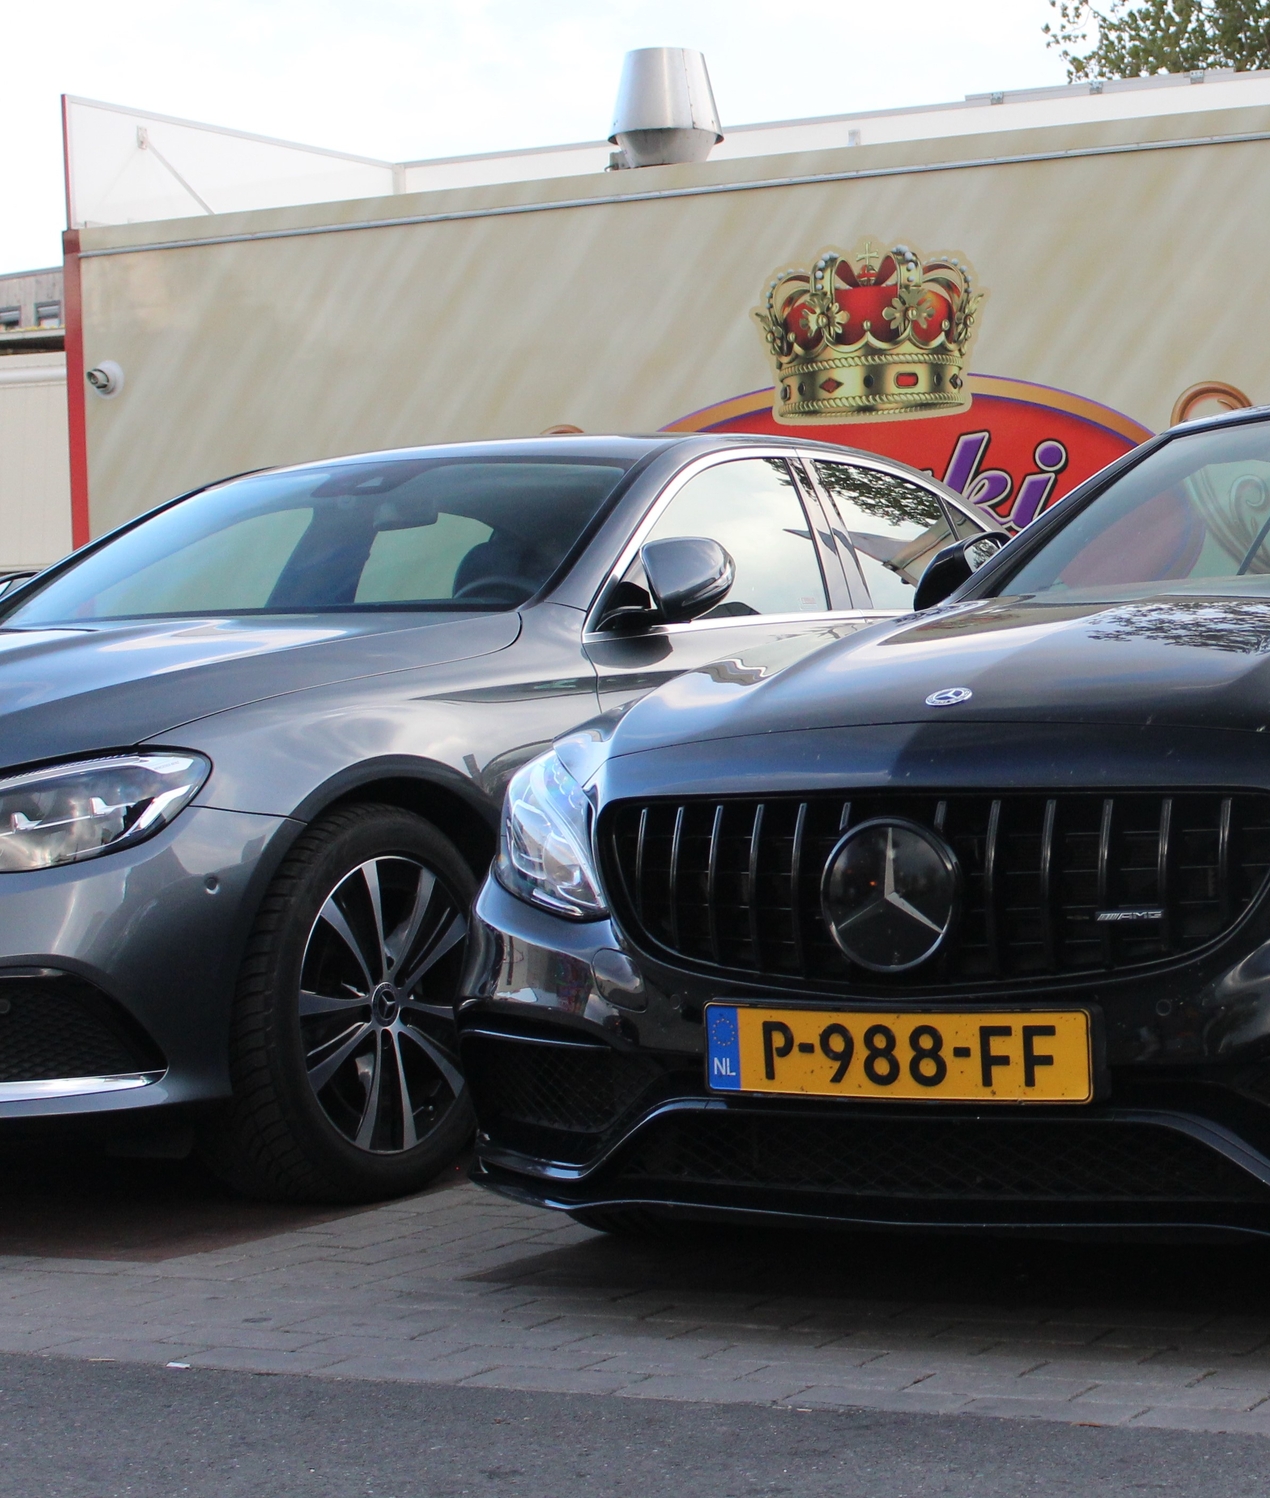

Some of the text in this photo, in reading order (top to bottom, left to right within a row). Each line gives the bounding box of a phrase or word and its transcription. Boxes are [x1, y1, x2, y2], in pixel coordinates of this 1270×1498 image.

[928, 430, 1067, 532] ki
[1116, 911, 1163, 920] AMG
[713, 1057, 736, 1077] NL
[761, 1020, 1056, 1087] P-988-FF
